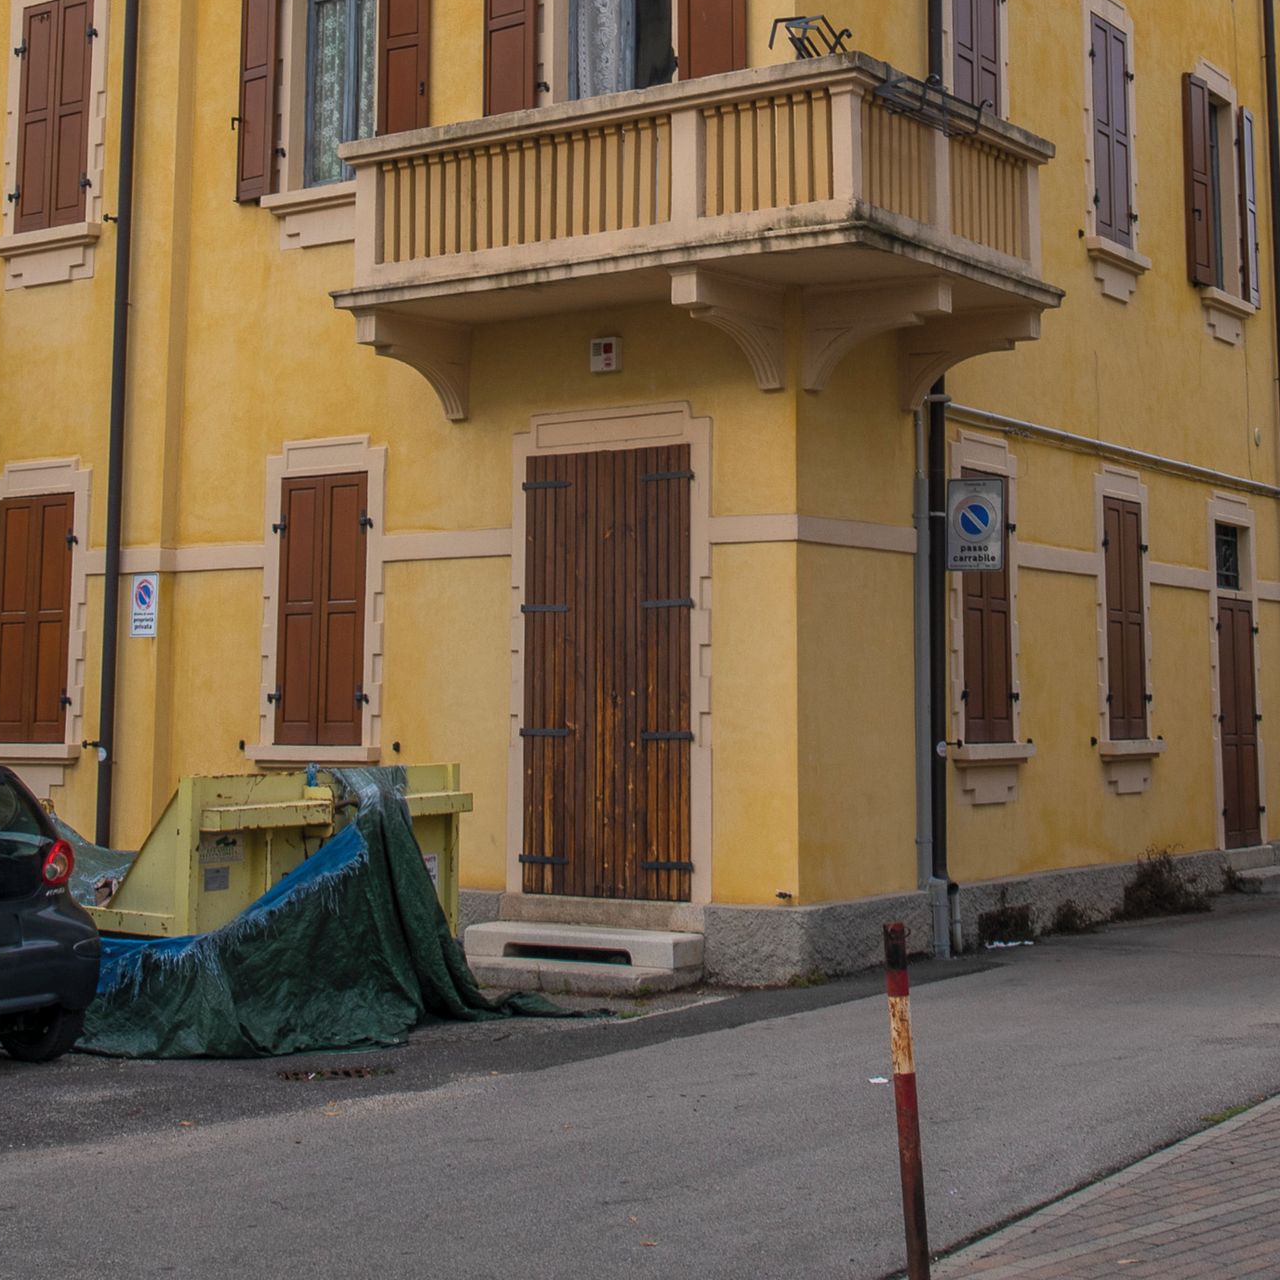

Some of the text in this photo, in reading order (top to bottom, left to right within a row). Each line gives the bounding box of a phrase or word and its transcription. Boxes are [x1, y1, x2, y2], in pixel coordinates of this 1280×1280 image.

[960, 544, 989, 554] passo
[952, 554, 996, 562] carrabile
[133, 623, 153, 631] privata
